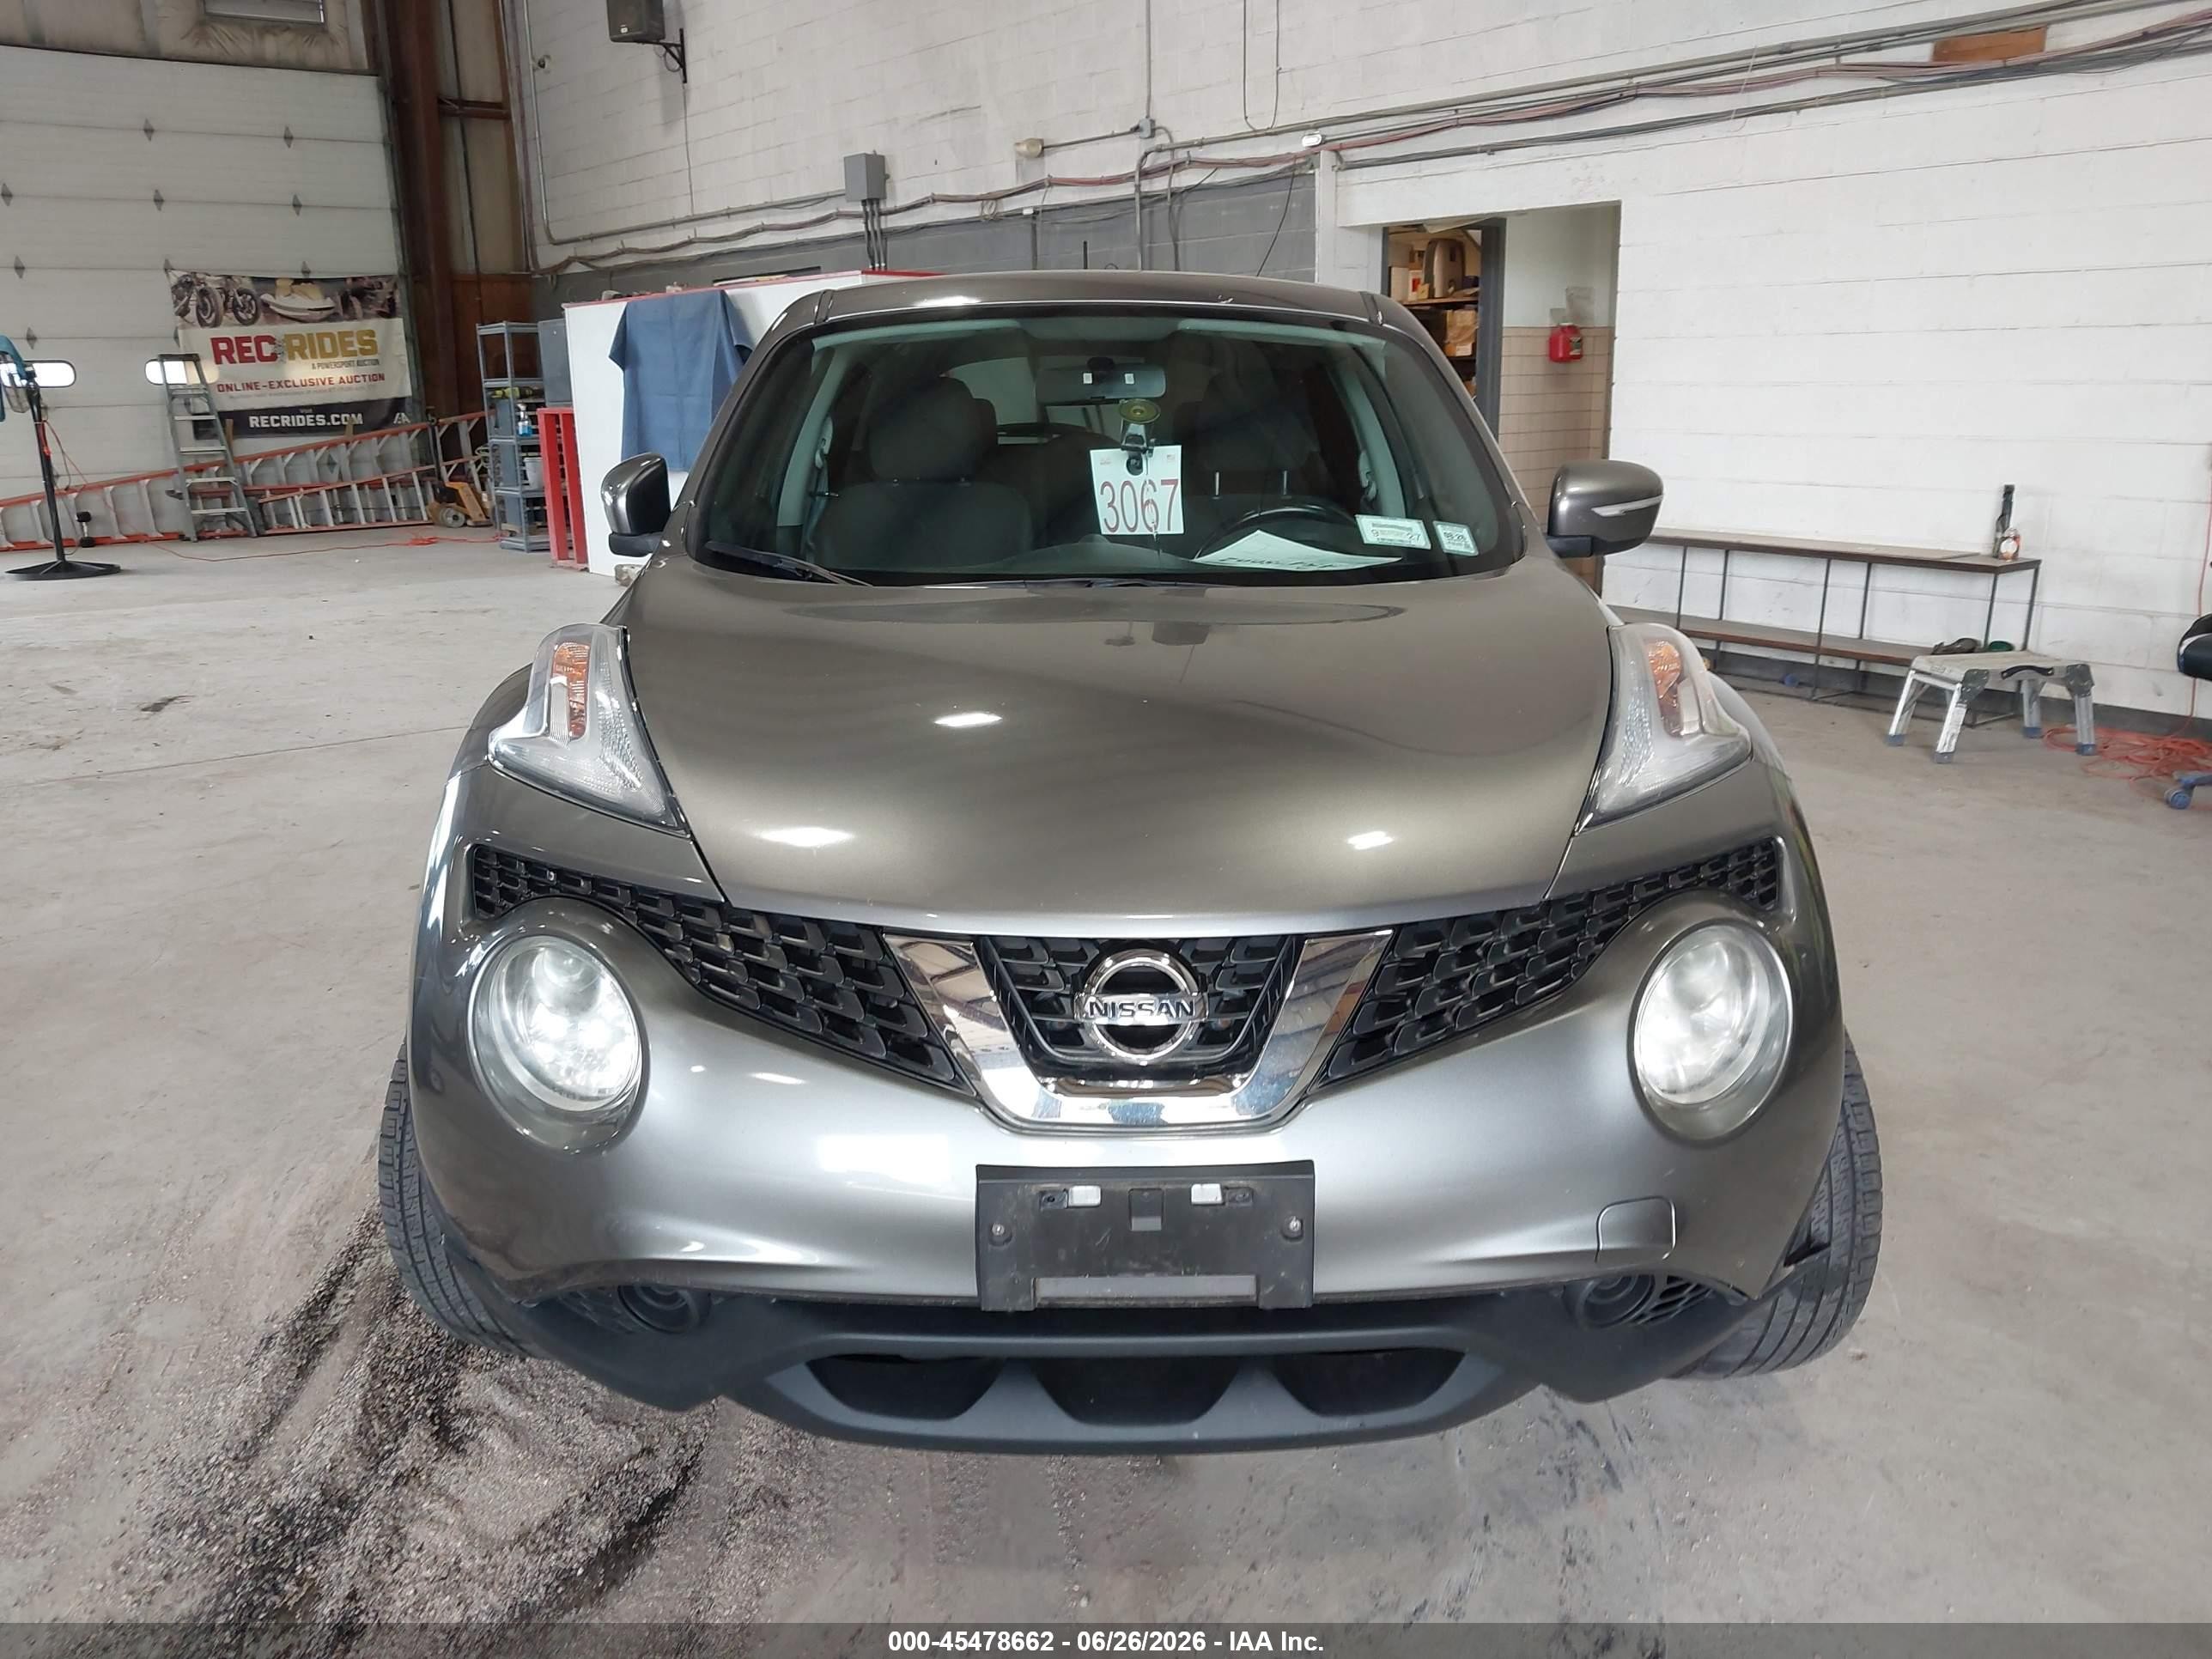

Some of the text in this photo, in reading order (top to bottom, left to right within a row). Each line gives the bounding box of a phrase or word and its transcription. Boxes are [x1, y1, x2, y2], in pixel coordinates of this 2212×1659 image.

[211, 330, 379, 364] REC RIDES
[218, 374, 385, 392] ONLINE-EXCLUSIVE AUCTION
[249, 414, 363, 428] RECRIDES.COM
[1100, 478, 1179, 532] 3067
[1090, 1001, 1194, 1018] NISSAN
